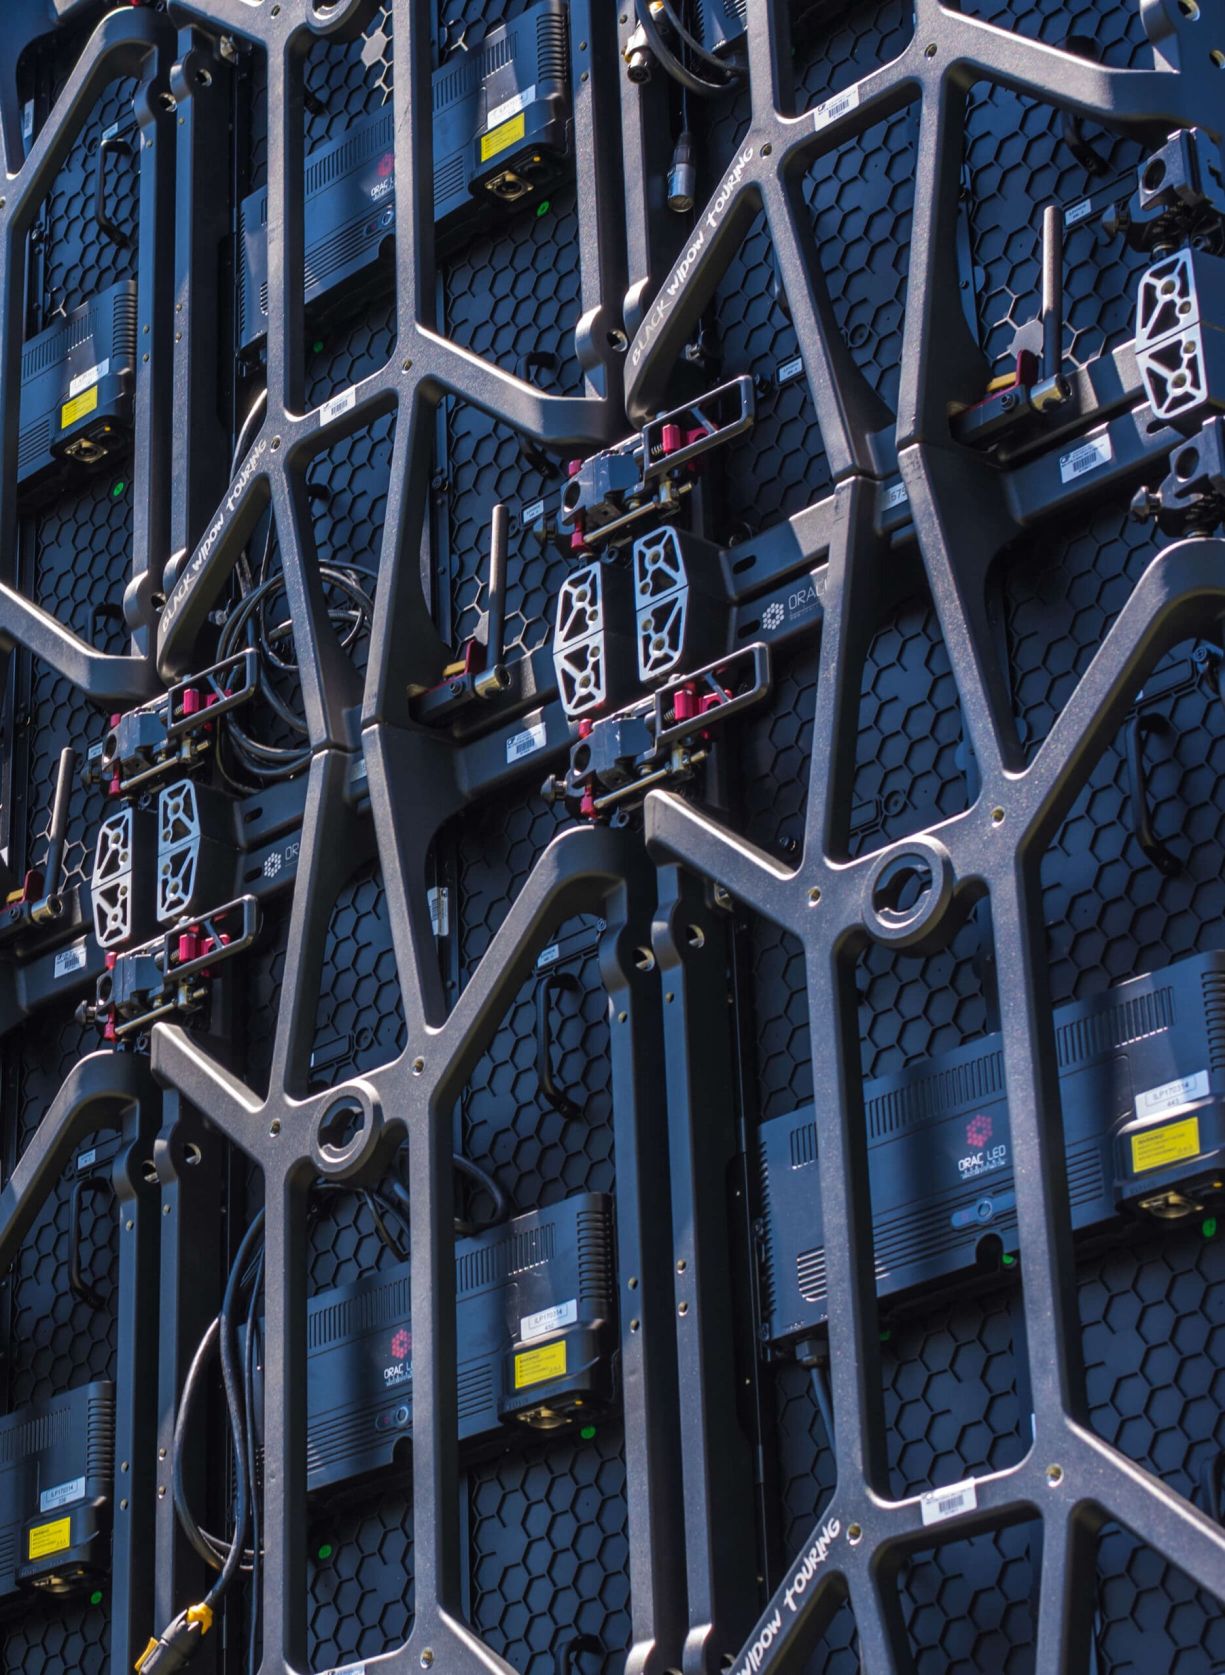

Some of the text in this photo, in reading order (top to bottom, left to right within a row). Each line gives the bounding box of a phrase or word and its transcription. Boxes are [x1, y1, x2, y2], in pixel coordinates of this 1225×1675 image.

[632, 147, 754, 366] BLACK WIDOW TOURING
[161, 439, 268, 632] BLACK WIDOW TOURING
[957, 1152, 984, 1171] ORAC
[986, 1144, 1006, 1161] LED
[383, 1362, 404, 1380] ORAC
[783, 1517, 841, 1612] TOURING
